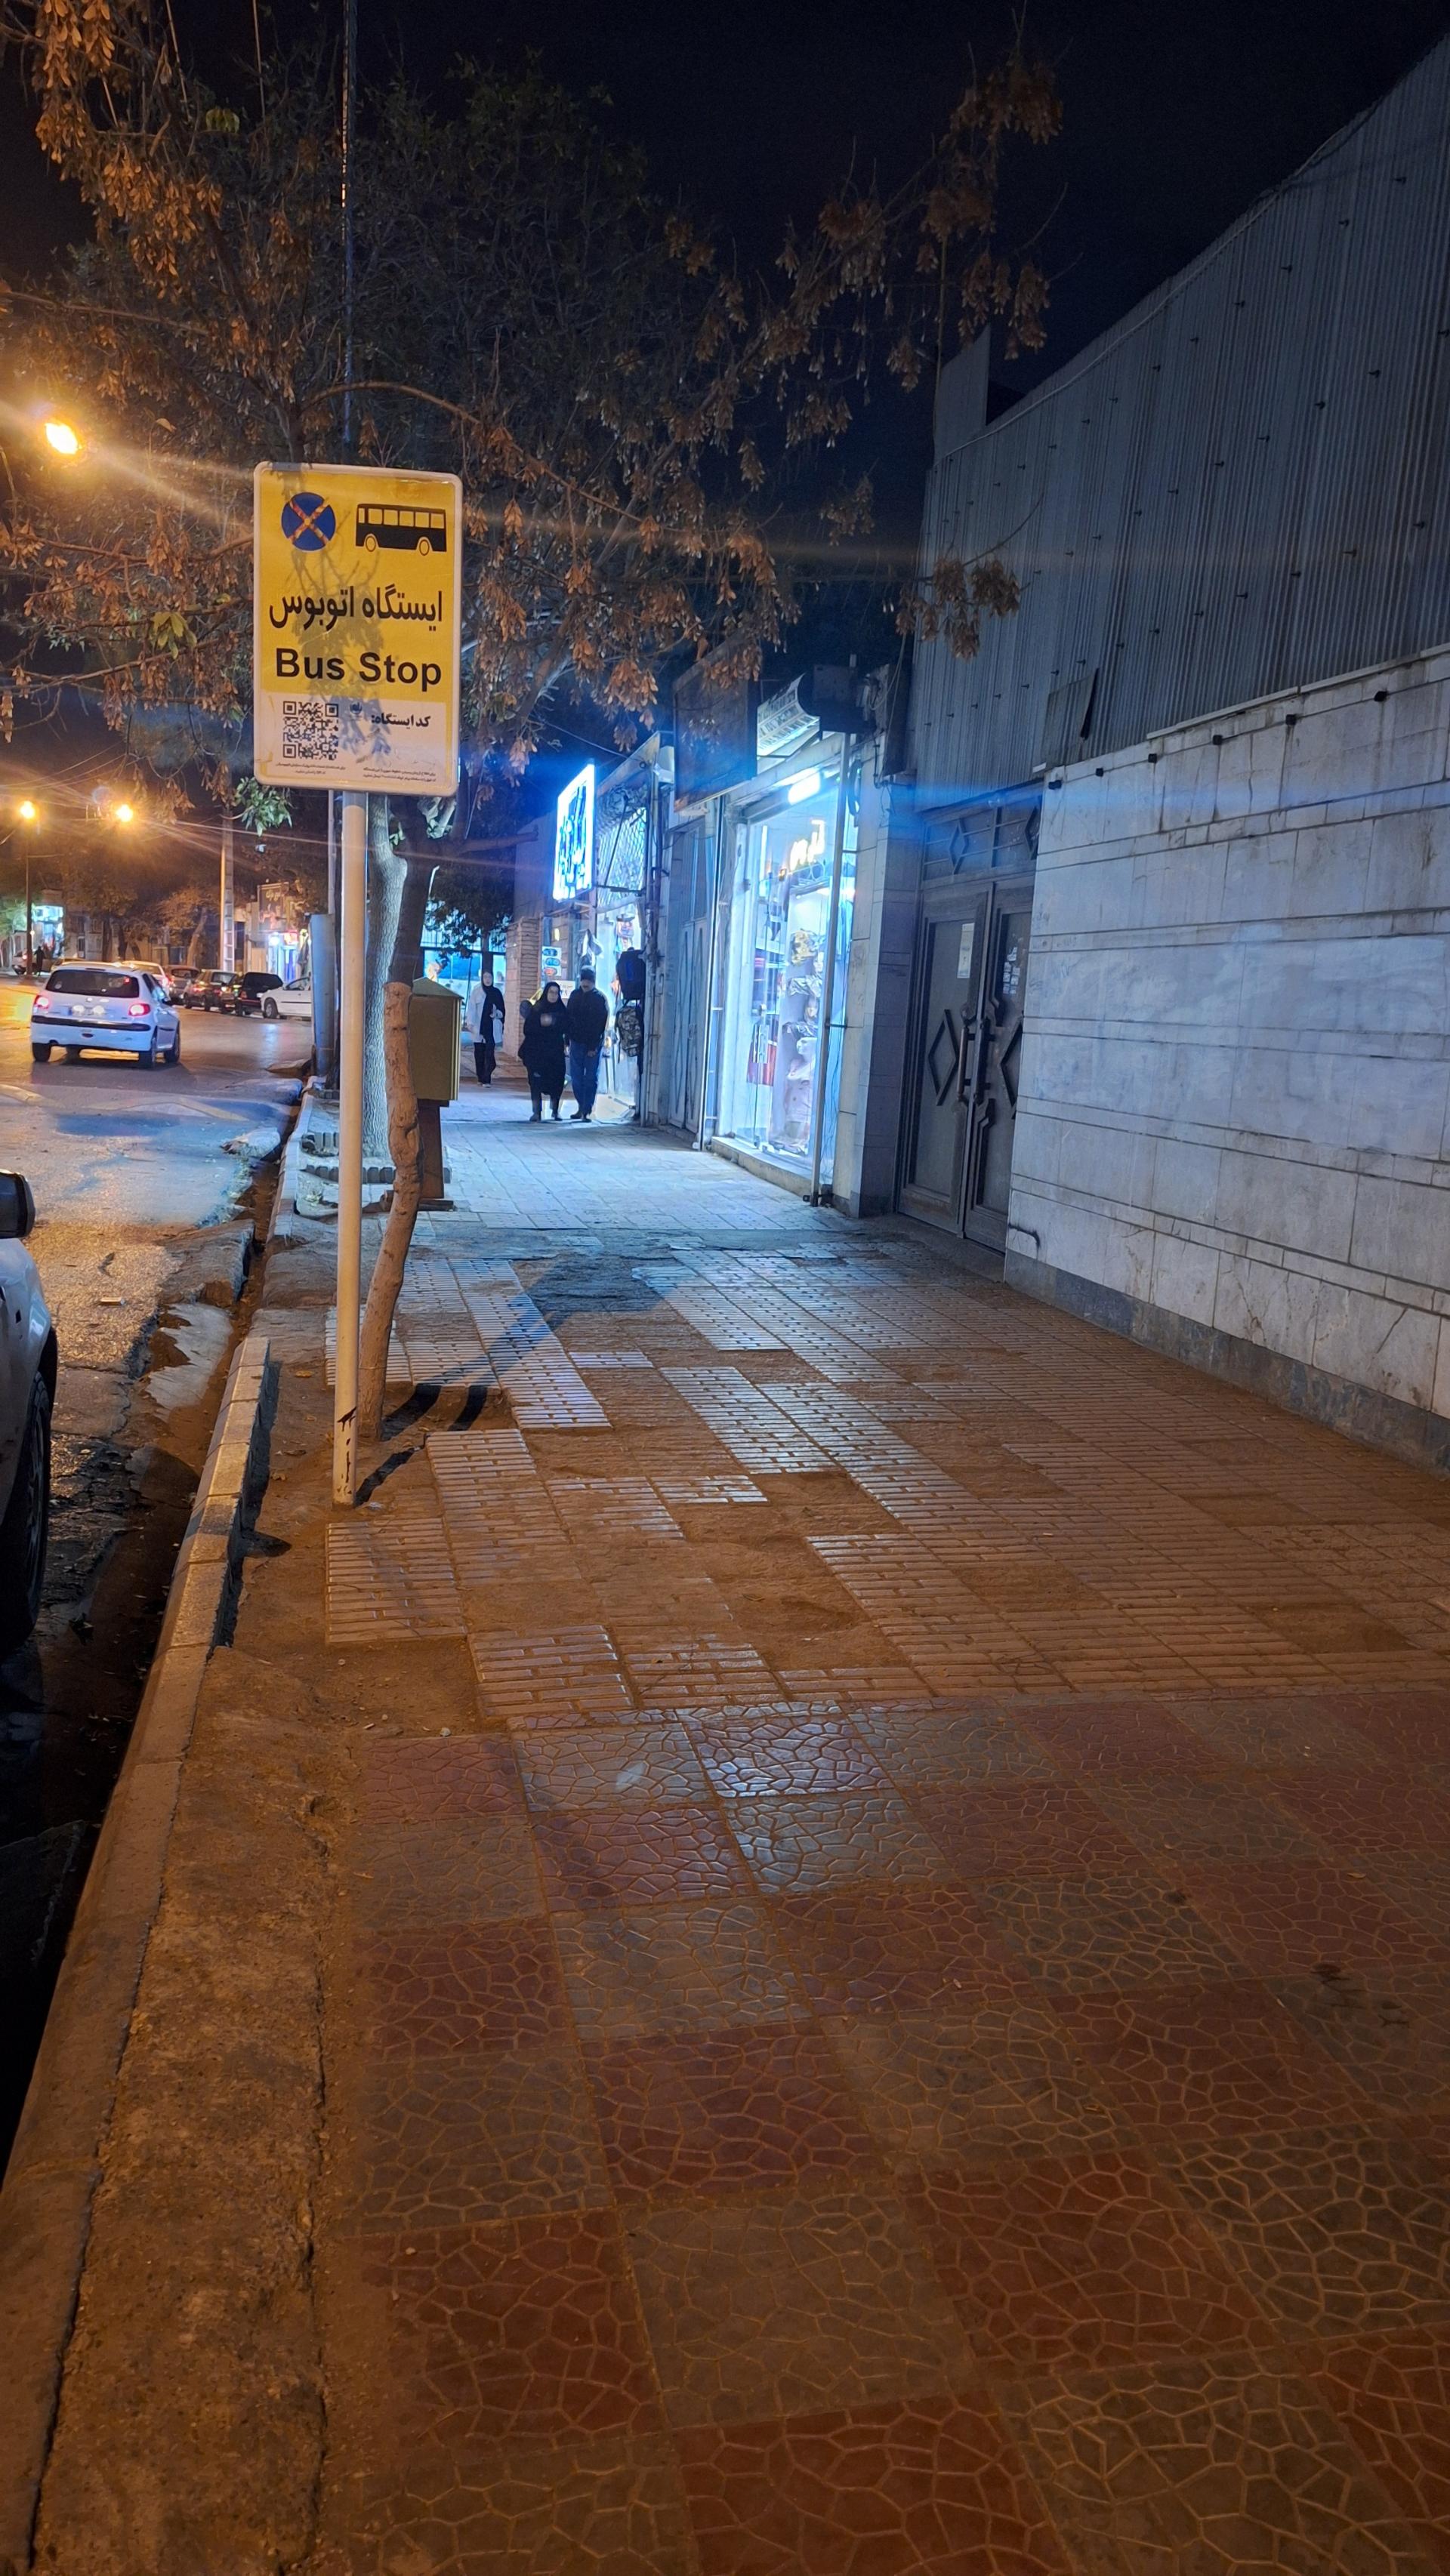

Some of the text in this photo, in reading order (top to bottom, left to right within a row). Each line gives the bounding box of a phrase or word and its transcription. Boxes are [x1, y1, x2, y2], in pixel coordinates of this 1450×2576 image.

[269, 583, 443, 631] ایستگاه اتوبوس
[276, 647, 442, 692] Bus Stop
[415, 716, 431, 727] کد
